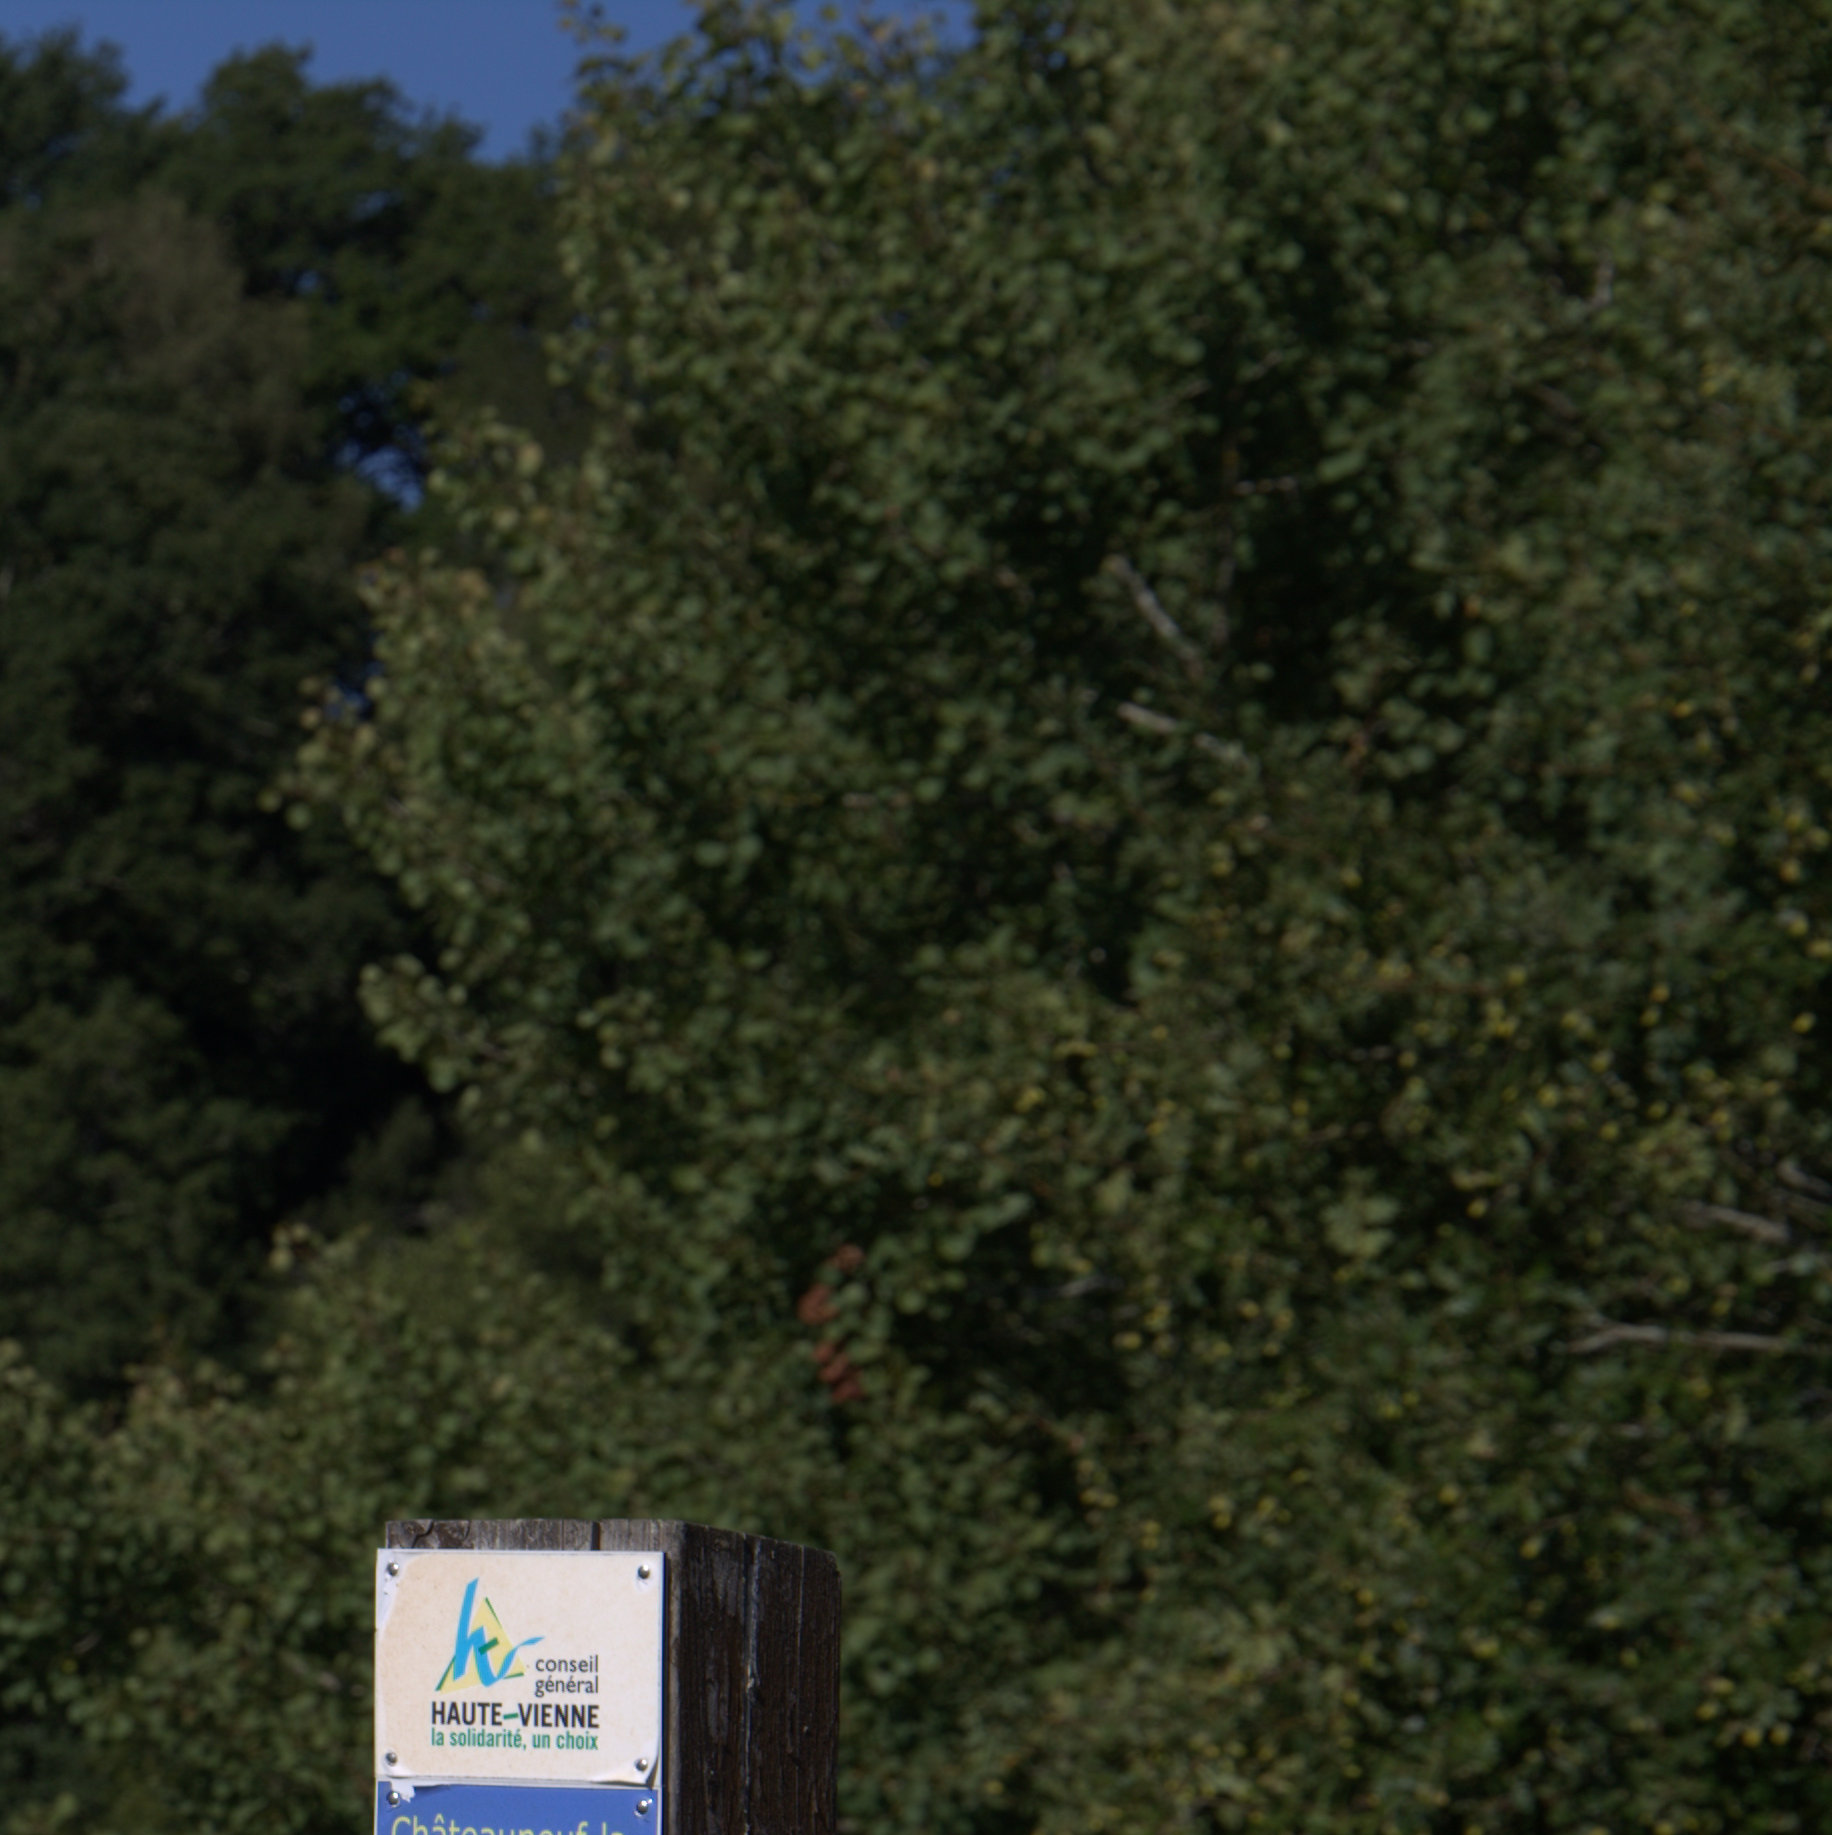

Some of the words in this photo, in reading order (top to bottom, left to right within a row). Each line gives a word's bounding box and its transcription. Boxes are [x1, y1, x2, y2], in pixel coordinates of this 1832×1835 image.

[536, 1654, 598, 1673] conseil
[534, 1676, 598, 1698] général
[431, 1702, 599, 1728] HAUTE-VIENNE
[431, 1728, 444, 1746] la
[450, 1730, 527, 1750] solidarité,
[532, 1734, 550, 1748] un
[556, 1730, 598, 1750] choix
